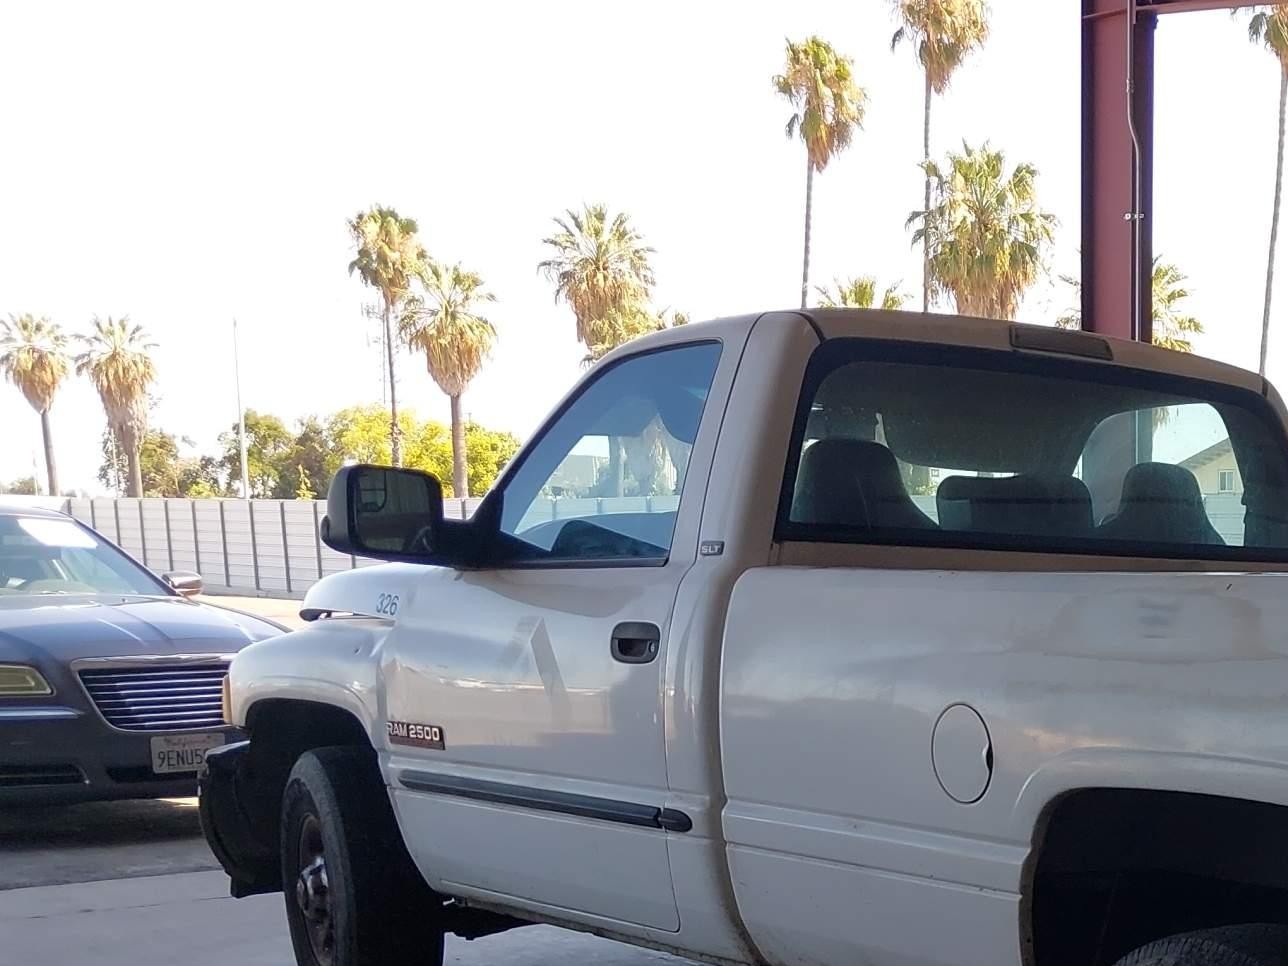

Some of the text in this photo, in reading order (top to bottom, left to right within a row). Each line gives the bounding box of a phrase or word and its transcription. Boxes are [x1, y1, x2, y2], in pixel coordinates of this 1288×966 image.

[701, 544, 721, 554] SLT
[376, 592, 400, 616] 326
[385, 721, 440, 741] RAM 2500
